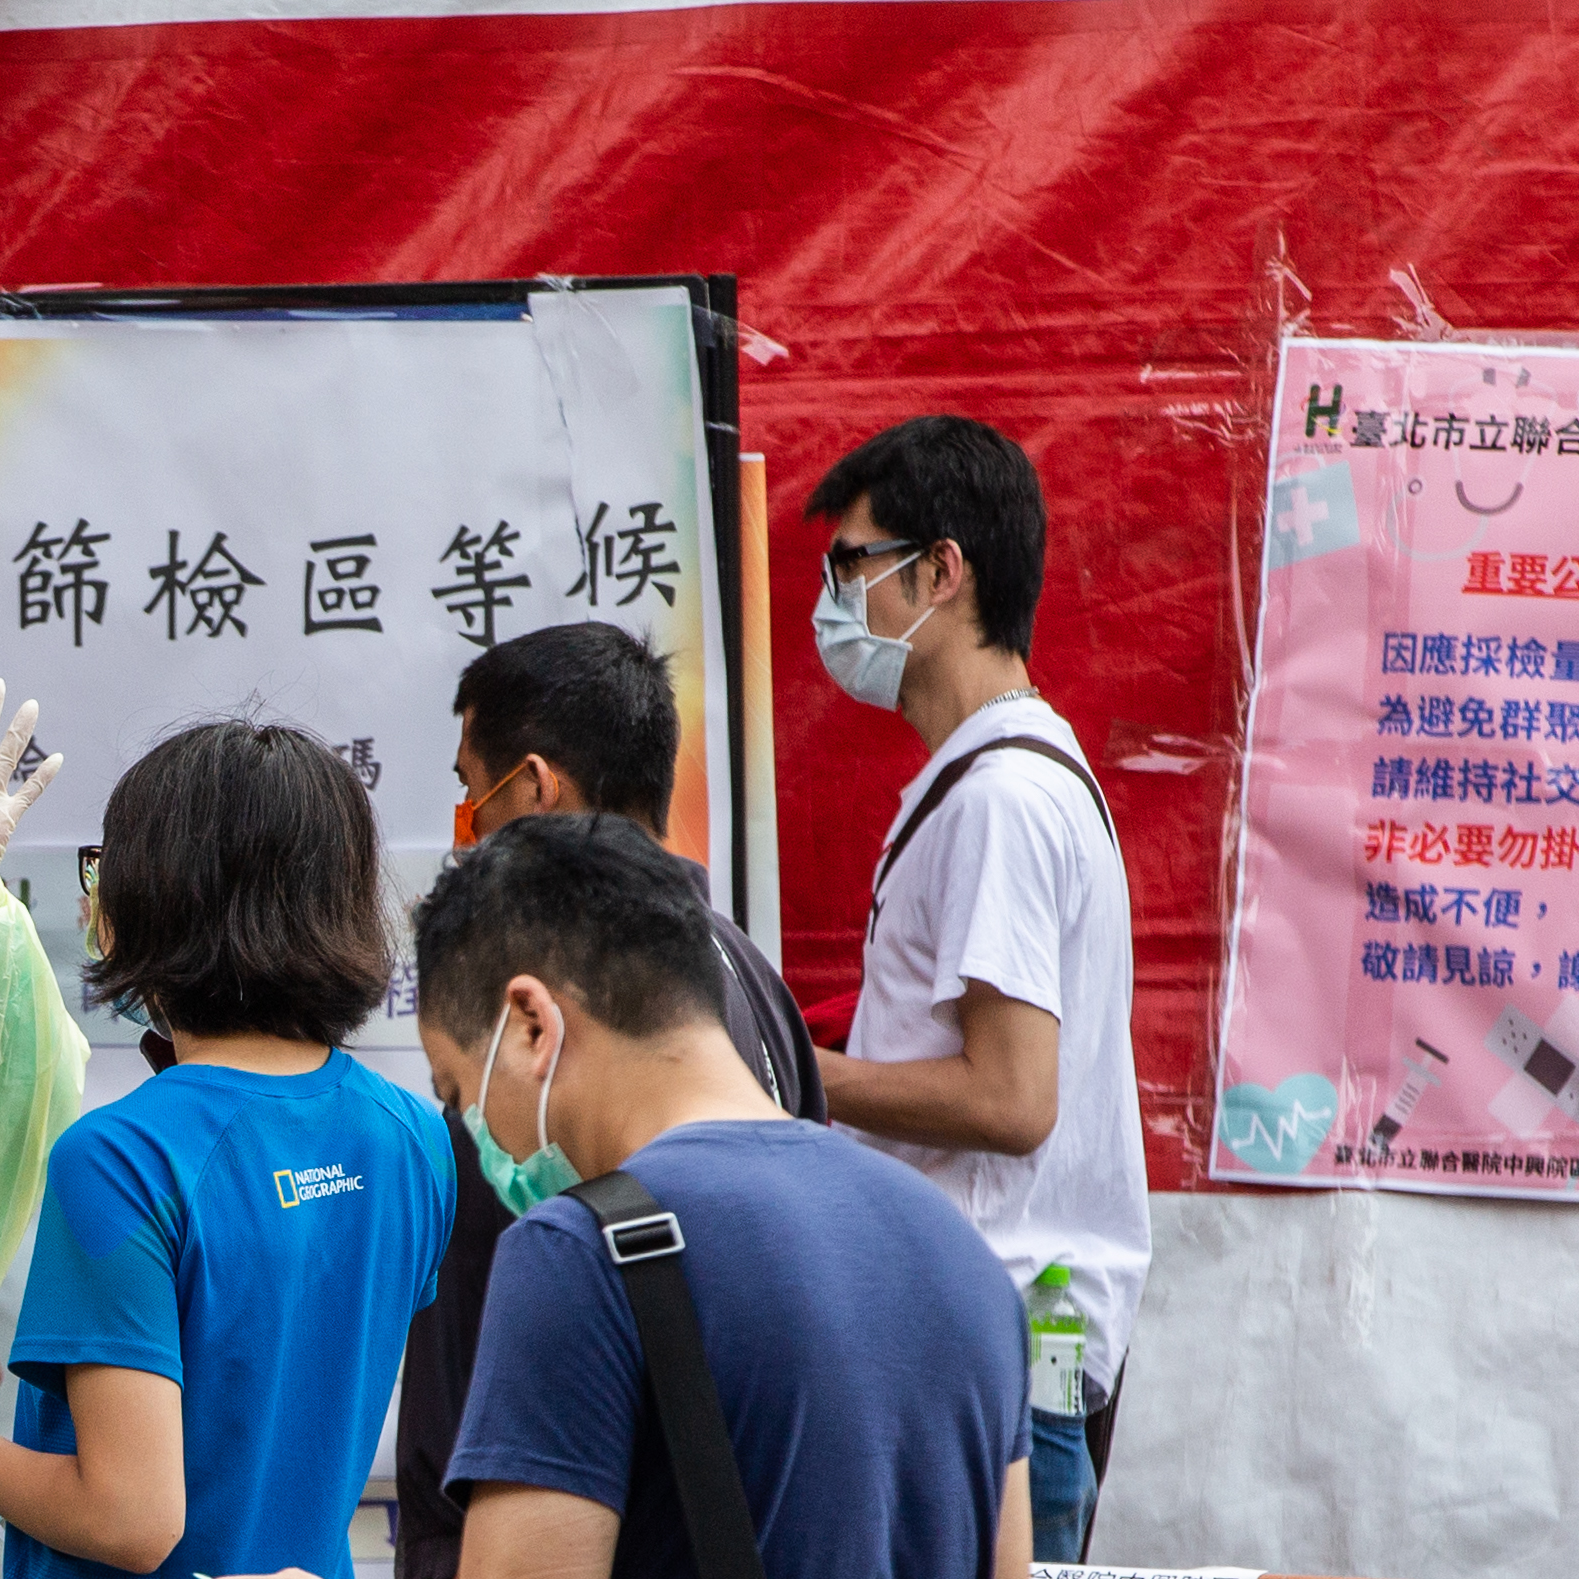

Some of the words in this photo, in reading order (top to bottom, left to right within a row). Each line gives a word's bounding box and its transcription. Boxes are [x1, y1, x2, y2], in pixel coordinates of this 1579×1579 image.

[12, 500, 683, 649] 篩檢區等候
[1381, 630, 1579, 683] 因應採檢量
[1376, 693, 1579, 744] 為避免群聚
[1371, 754, 1579, 806] 請維持社交
[1364, 818, 1579, 872] 非必要勿掛
[294, 1163, 346, 1185] NATIONAL
[298, 1175, 365, 1201] GEOGRAPHIC
